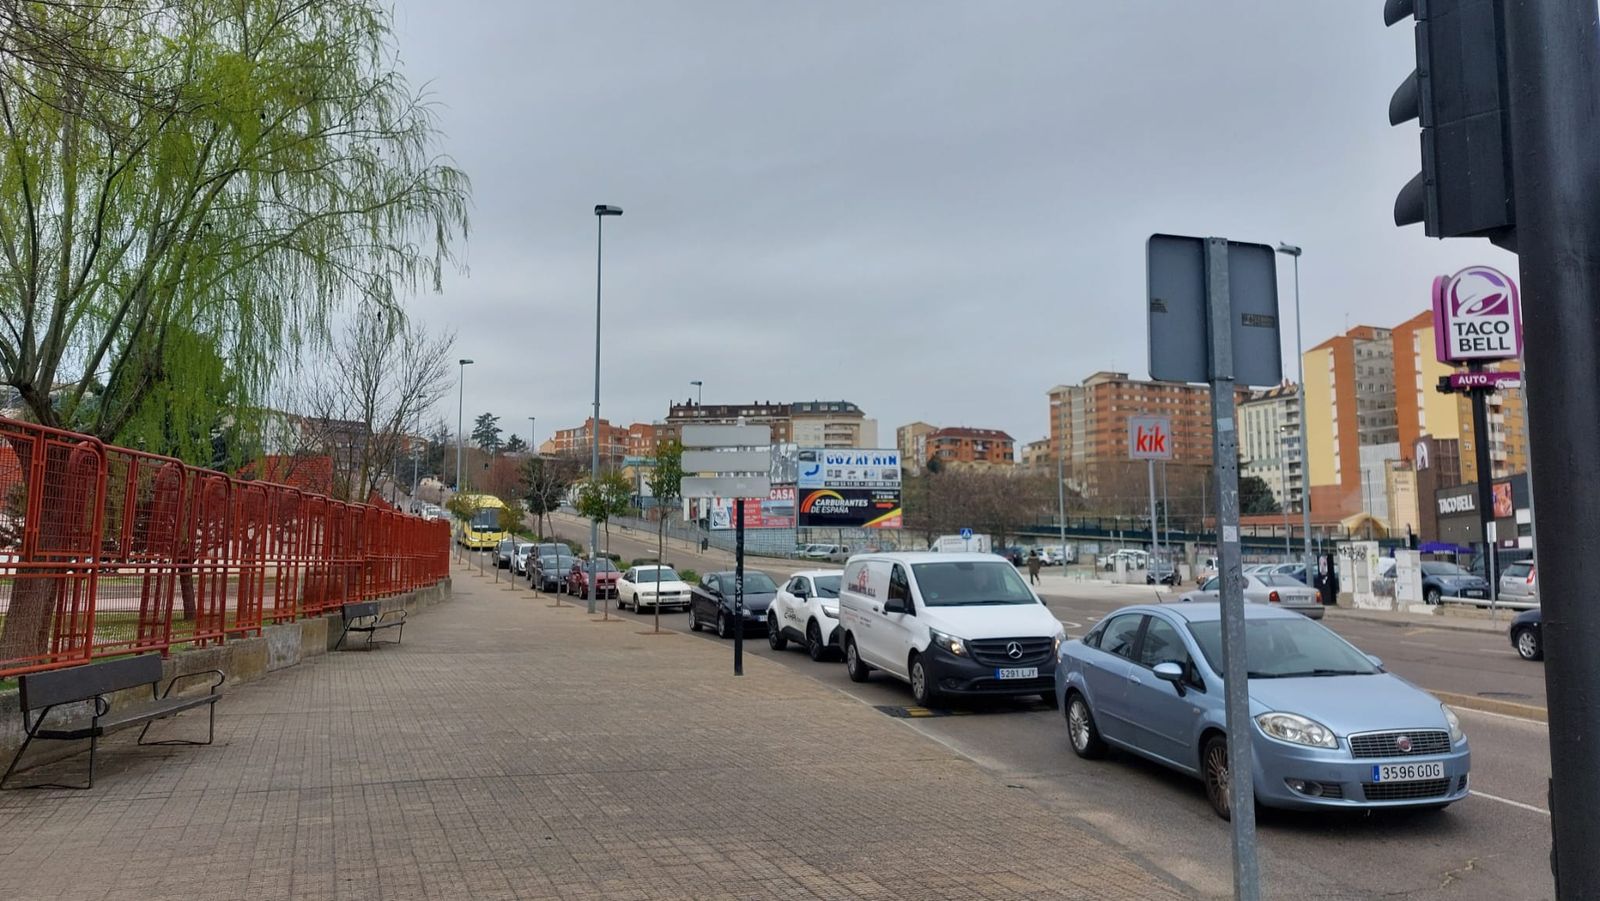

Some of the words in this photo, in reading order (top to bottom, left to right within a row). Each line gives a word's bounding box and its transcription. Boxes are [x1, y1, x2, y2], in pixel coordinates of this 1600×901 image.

[1453, 321, 1509, 336] TACO
[1459, 336, 1511, 352] BELL
[1458, 375, 1487, 384] AUTO
[1136, 424, 1166, 453] kik
[770, 488, 795, 500] CASA
[811, 506, 822, 514] DE
[821, 505, 849, 514] ESPAÑA
[815, 499, 869, 507] CARBURANTES
[1438, 497, 1457, 514] TACO
[1456, 494, 1475, 512] BELL
[1382, 766, 1415, 779] 3596
[1417, 764, 1440, 778] GDG
